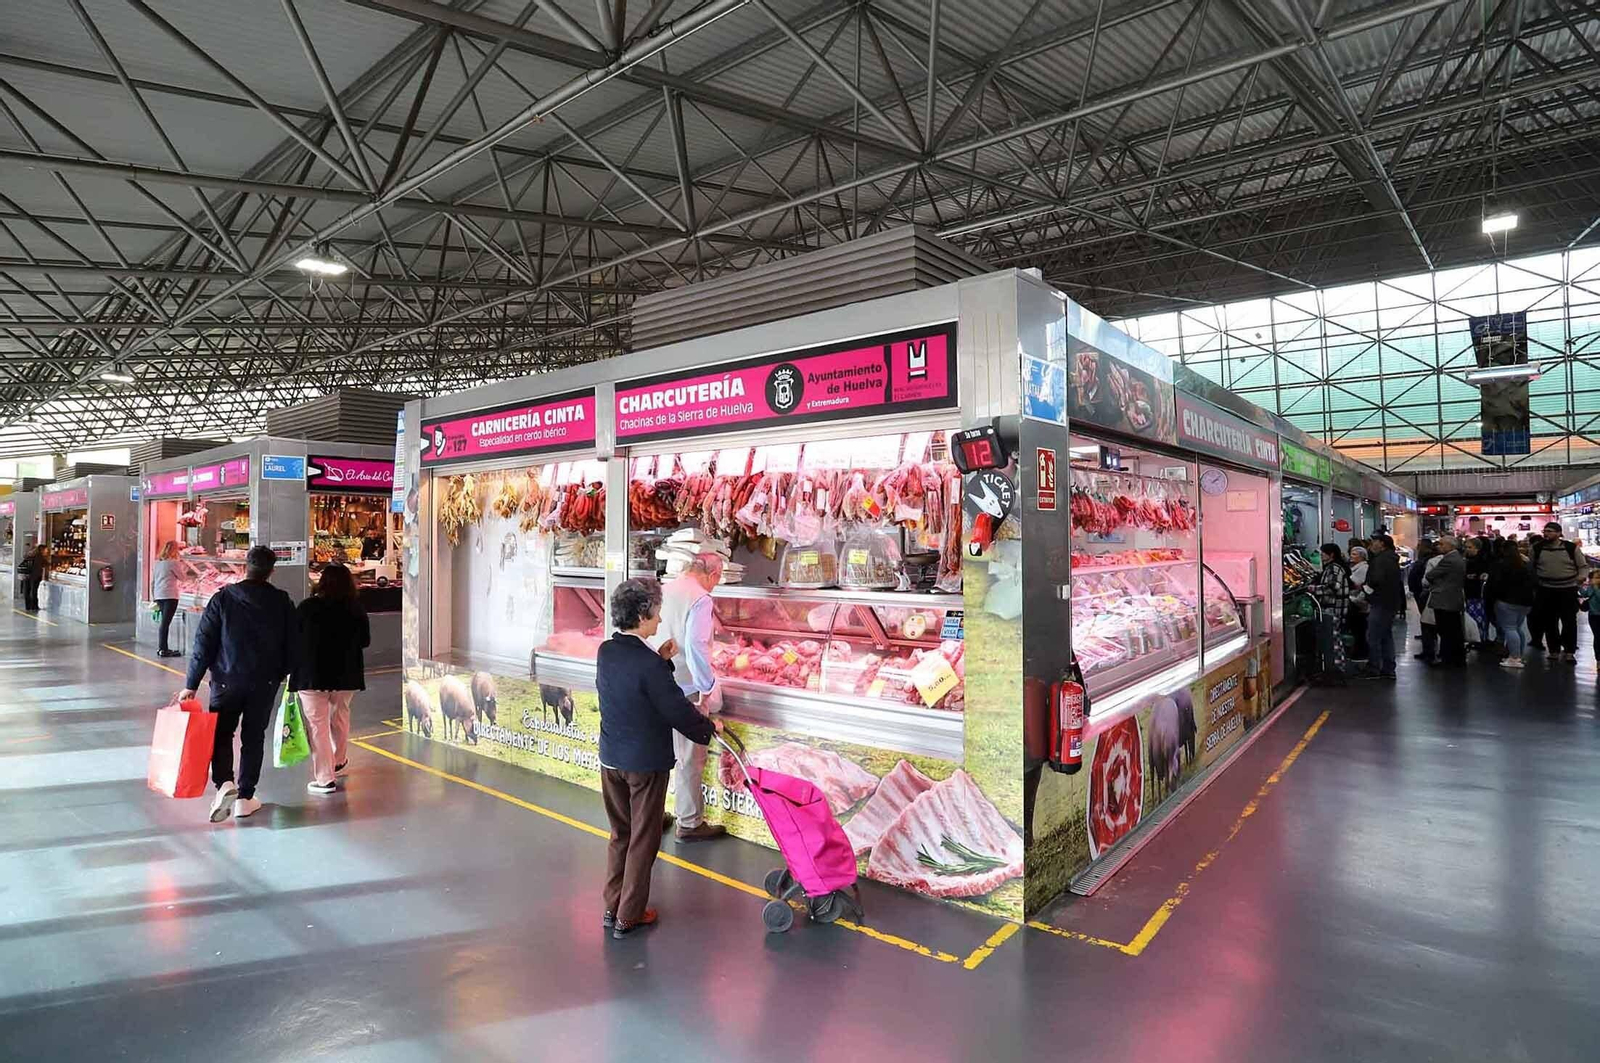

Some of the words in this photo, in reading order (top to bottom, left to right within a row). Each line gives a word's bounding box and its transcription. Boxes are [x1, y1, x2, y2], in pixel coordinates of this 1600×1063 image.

[808, 362, 882, 384] Ayuntamiento
[827, 384, 840, 394] de
[844, 378, 882, 393] Huelva
[620, 374, 745, 414] CHARCUTERÍA
[811, 396, 849, 407] Extremadura
[471, 409, 541, 437] CARNICERÍA
[544, 404, 585, 426] CINTA
[620, 416, 653, 430] Chacinas
[656, 413, 666, 424] de
[668, 413, 676, 423] la
[678, 410, 703, 422] Sierra
[706, 407, 718, 418] de
[720, 402, 753, 416] Huelva
[453, 439, 467, 452] 127
[479, 434, 513, 448] Especialidad
[515, 433, 523, 442] en
[524, 430, 542, 441] cerdo
[543, 426, 567, 439] ibérico
[1183, 408, 1253, 455] CHARCUTERÍA
[1255, 438, 1277, 463] CINTA
[971, 440, 993, 466] 12
[983, 474, 1011, 508] TICKET
[522, 708, 586, 742] Especialistas
[473, 720, 535, 753] DIRECTAMENTE
[537, 739, 549, 758] DE
[552, 741, 570, 764] LOS
